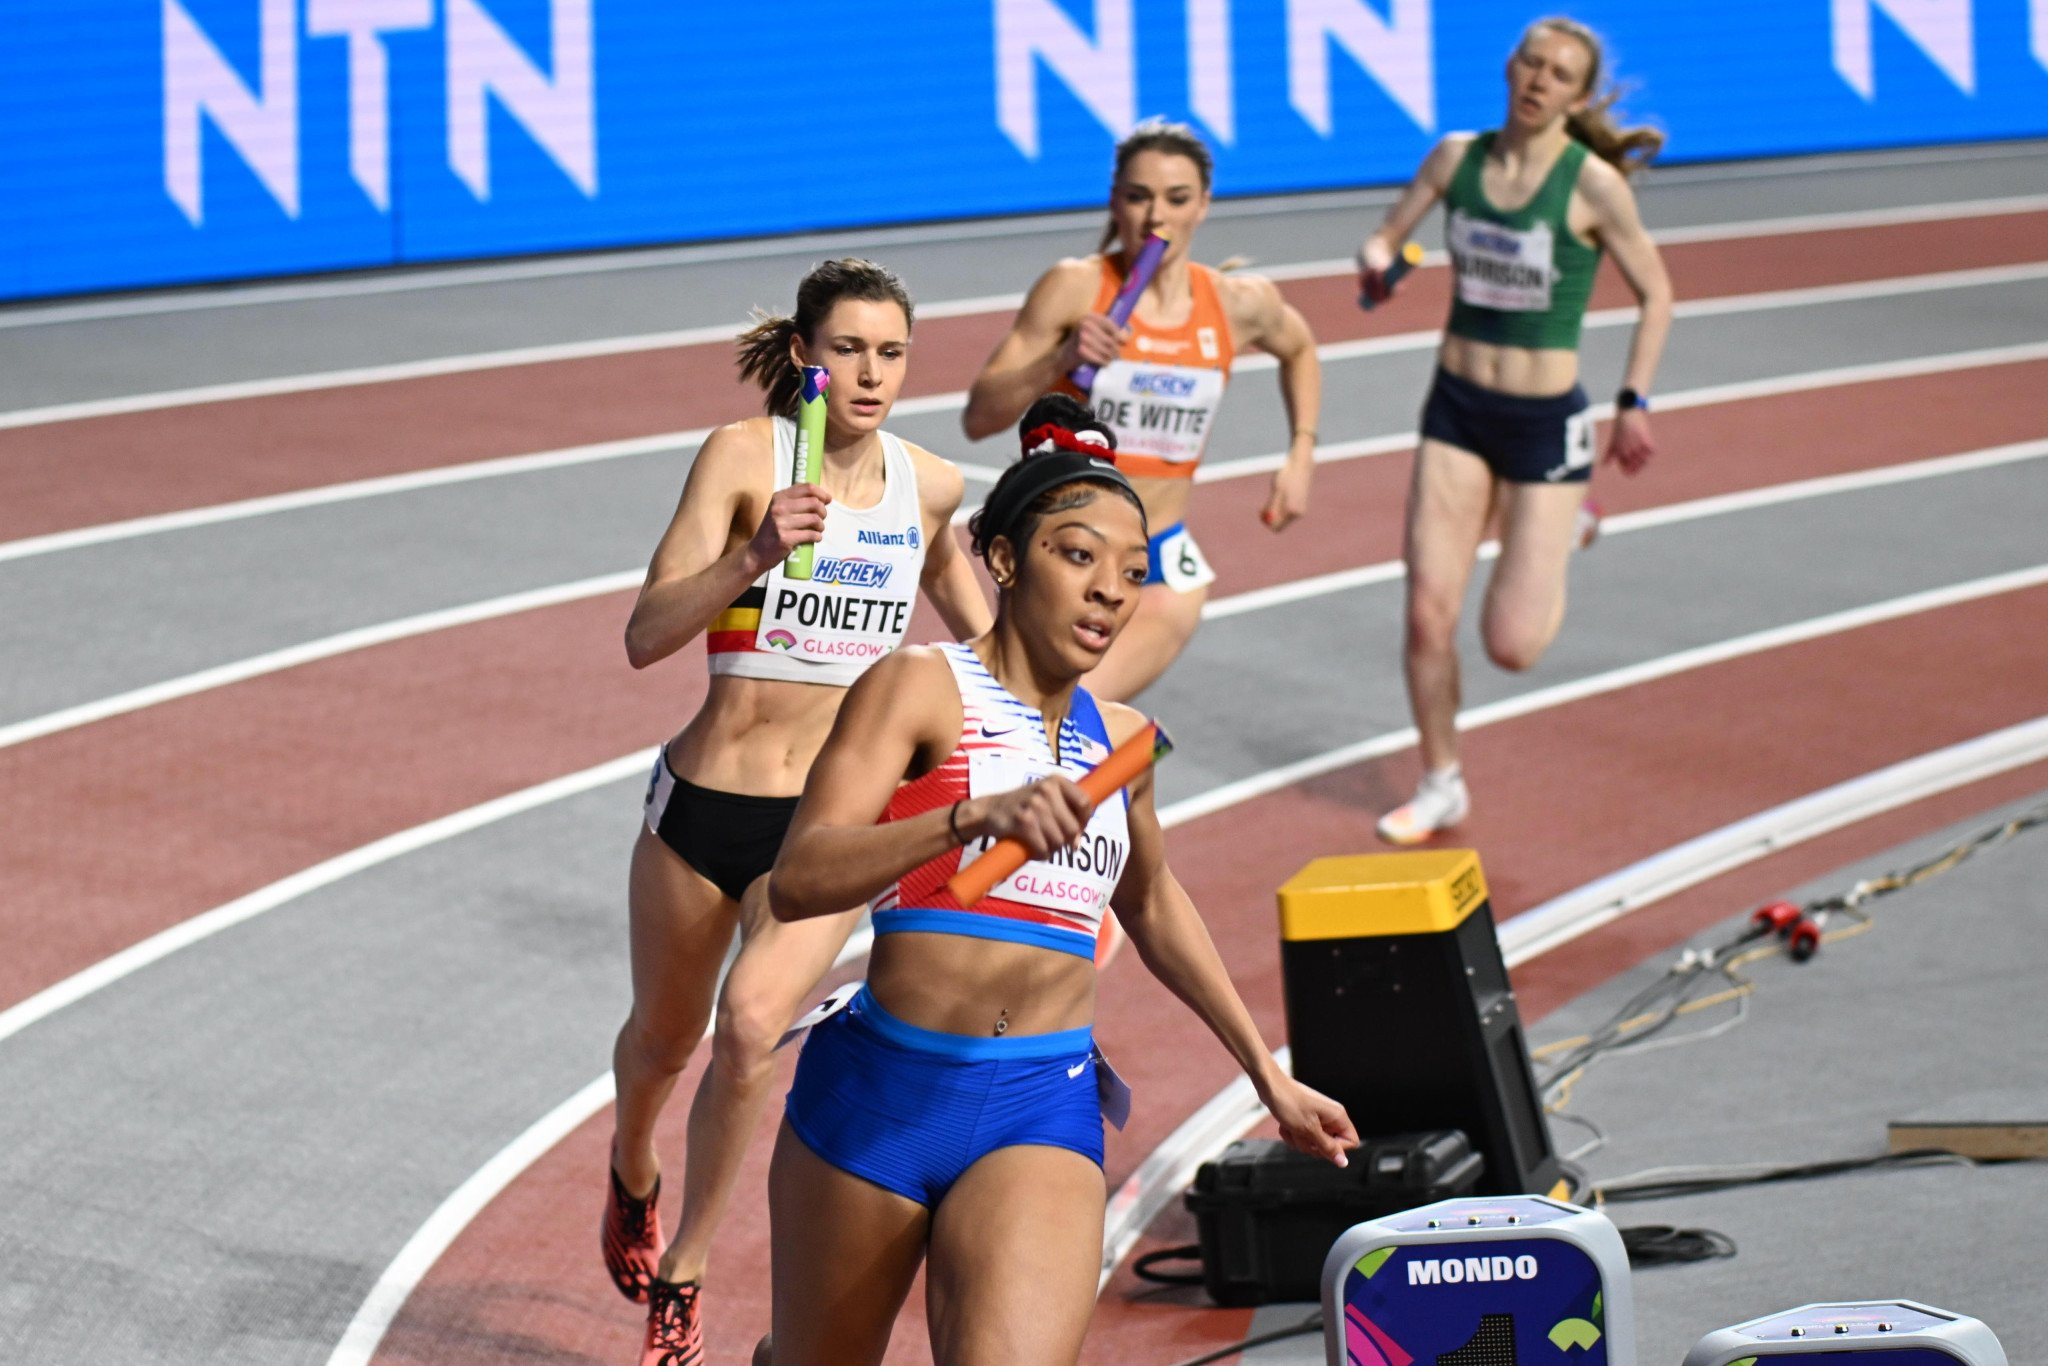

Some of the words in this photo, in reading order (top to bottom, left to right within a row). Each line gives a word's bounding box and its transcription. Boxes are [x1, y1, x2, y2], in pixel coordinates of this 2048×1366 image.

[162, 0, 598, 228] NTN
[1097, 399, 1132, 428] DE
[1140, 402, 1208, 434] WITTE
[857, 530, 905, 546] Allianz
[812, 557, 893, 588] HI-CHEW
[1178, 541, 1197, 577] 6
[775, 590, 907, 634] PONETTE
[803, 638, 884, 657] GLASGOW
[1014, 874, 1102, 906] GLASGOW
[1407, 1254, 1539, 1286] MONDO
